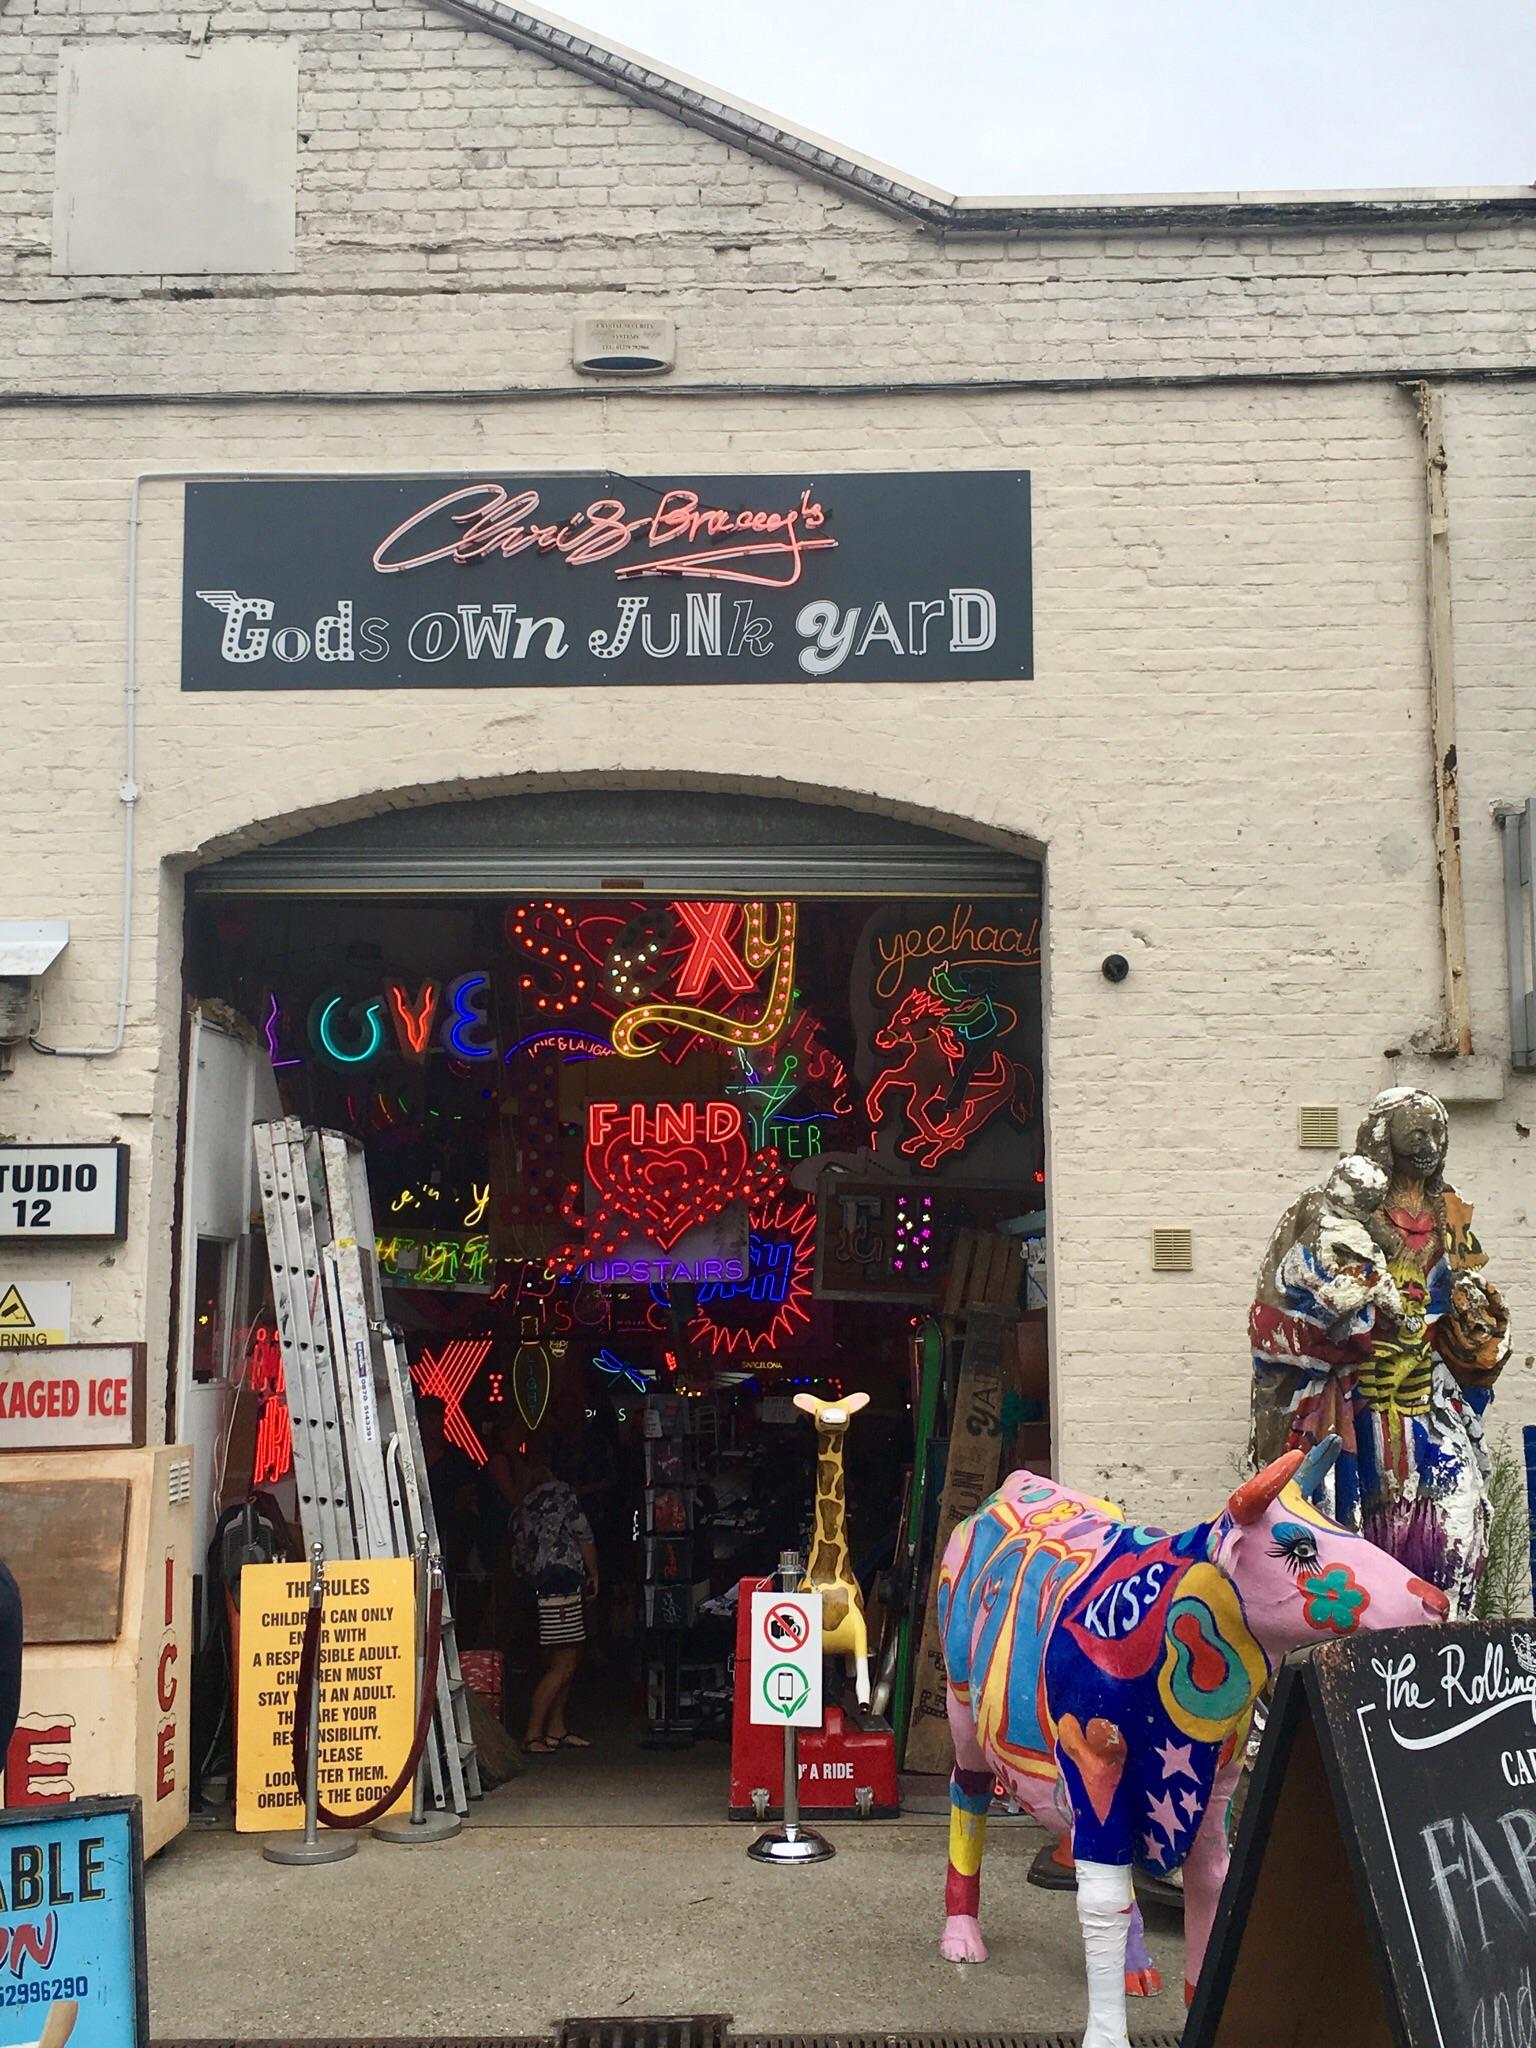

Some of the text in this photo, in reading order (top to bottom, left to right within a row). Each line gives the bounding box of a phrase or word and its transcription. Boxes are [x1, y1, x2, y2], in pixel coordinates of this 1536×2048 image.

[372, 484, 630, 573] Chris
[196, 591, 390, 663] Gods
[589, 1102, 742, 1146] FIND
[12, 1199, 51, 1228] 12
[589, 1259, 743, 1283] UPSTAIRS
[88, 1378, 128, 1417] ICE
[322, 1578, 370, 1597] RULES
[1084, 1563, 1163, 1638] KISS
[262, 1607, 394, 1627] CHILDRN CAN ONLY
[289, 1628, 366, 1645] ENR WITH
[253, 1646, 401, 1667] A RESPSIBLE ADULT.
[276, 1666, 383, 1685] CHIREN MUST
[1371, 1642, 1536, 1726] The Rolling
[258, 1691, 289, 1706] STAY
[331, 1687, 349, 1702] AN
[353, 1685, 396, 1700] ADULT.
[342, 1706, 377, 1721] YOUR
[273, 1726, 381, 1746] RESNSIBILITY.
[318, 1747, 363, 1763] PLEASE
[315, 1768, 344, 1783] TER
[347, 1766, 388, 1781] THEM.
[810, 1763, 820, 1780] A
[823, 1762, 855, 1780] RIDE
[327, 1788, 352, 1804] THE
[0, 1836, 105, 1913] BLE
